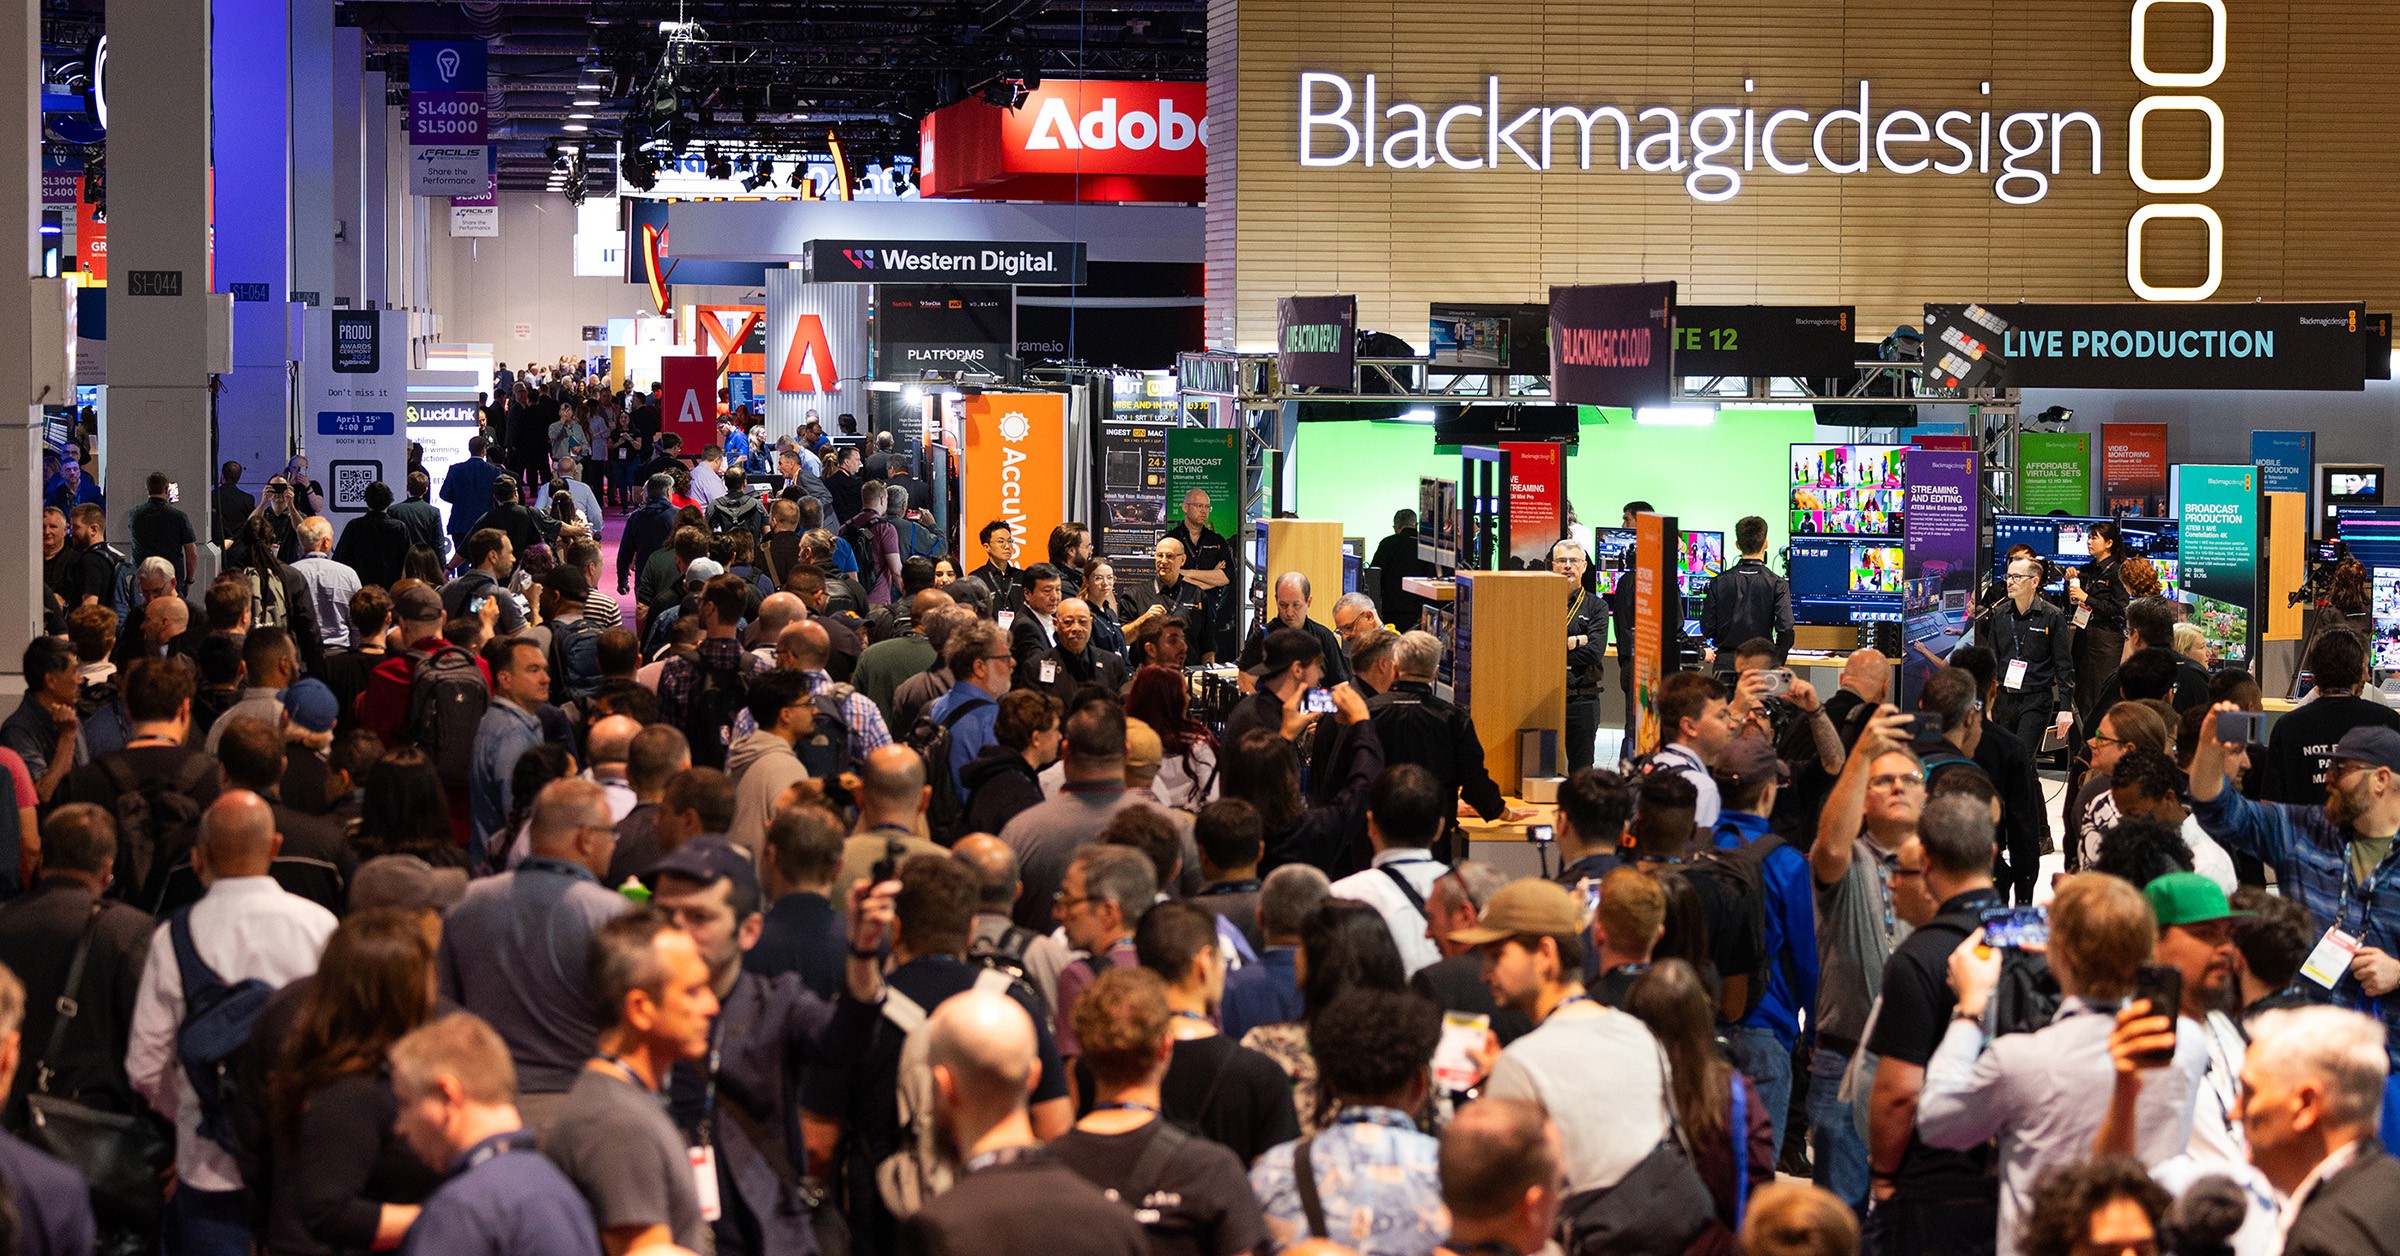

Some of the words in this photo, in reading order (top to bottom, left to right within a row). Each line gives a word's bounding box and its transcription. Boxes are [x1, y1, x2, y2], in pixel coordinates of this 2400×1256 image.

[418, 101, 486, 115] SL4000-
[418, 120, 478, 134] SL5000
[1300, 72, 2102, 203] Blackmagicdesign
[428, 168, 452, 176] Share
[454, 168, 468, 176] the
[422, 177, 476, 185] Performance
[881, 249, 976, 271] Western
[133, 272, 177, 294] S1-044
[234, 284, 266, 300] S1-054
[1796, 318, 1840, 326] Blackmagicdesign
[2300, 317, 2349, 326] Blackmagicdesign
[340, 325, 372, 340] PRODU
[1286, 326, 1298, 353] LIVE
[1298, 325, 1319, 352] ACTION
[1319, 324, 1341, 353] REPLAY
[1674, 328, 1702, 350] TE
[1709, 328, 1738, 350] 12
[2004, 330, 2062, 358] LIVE
[2072, 330, 2274, 358] PRODUCTION
[1016, 340, 1064, 352] rame.io
[1563, 328, 1618, 367] BLACKMAGIC
[1620, 328, 1650, 368] CLOUD
[908, 349, 985, 361] PLATFORMS
[328, 389, 351, 397] Don't
[355, 389, 374, 397] miss
[379, 389, 388, 397] it
[1134, 401, 1152, 409] AND
[420, 408, 476, 420] LucidLink
[336, 416, 360, 424] April
[366, 416, 380, 424] 15th
[338, 424, 358, 432] 4:00
[364, 424, 374, 432] pm
[413, 438, 436, 446] abling
[1148, 458, 1160, 466] 24
[2208, 478, 2245, 486] Blackmagicdesign
[1911, 485, 1958, 494] STREAMING
[1002, 446, 1026, 569] AccuWe
[2185, 504, 2239, 514] BROADCAST
[2185, 514, 2242, 523] PRODUCTION
[2303, 744, 2328, 756] NOT
[2332, 744, 2339, 753] F
[2318, 759, 2332, 769] PA
[2312, 773, 2326, 784] MA
